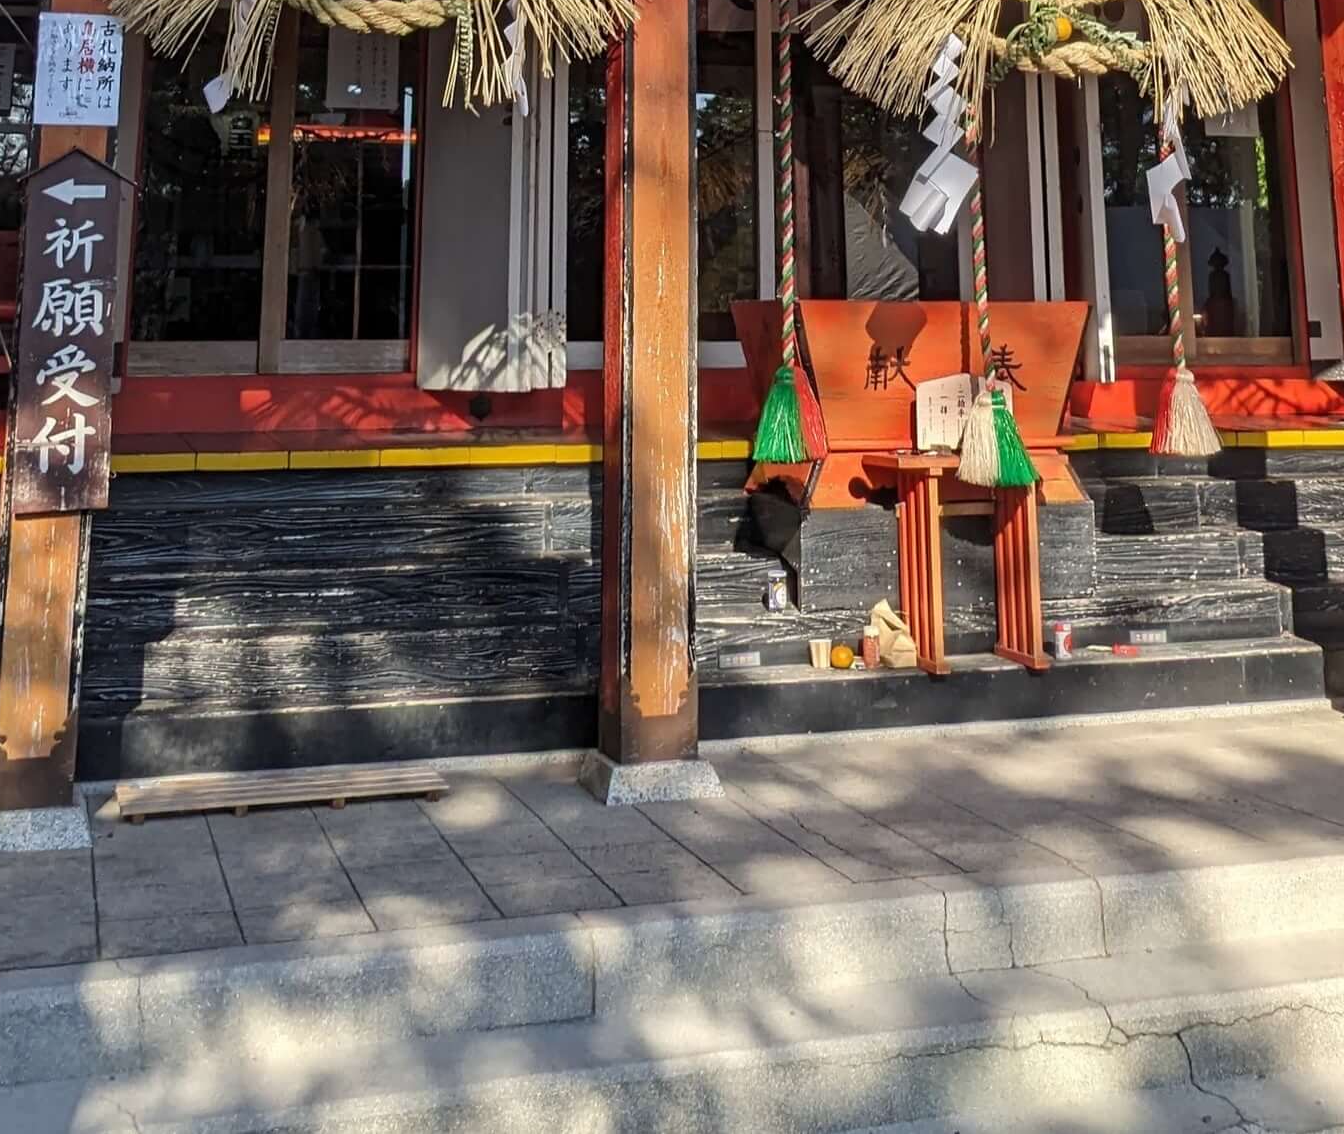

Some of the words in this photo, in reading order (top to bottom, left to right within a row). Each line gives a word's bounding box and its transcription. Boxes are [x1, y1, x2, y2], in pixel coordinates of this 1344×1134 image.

[96, 20, 117, 109] 古札納所は
[32, 218, 105, 474] 祈願受付
